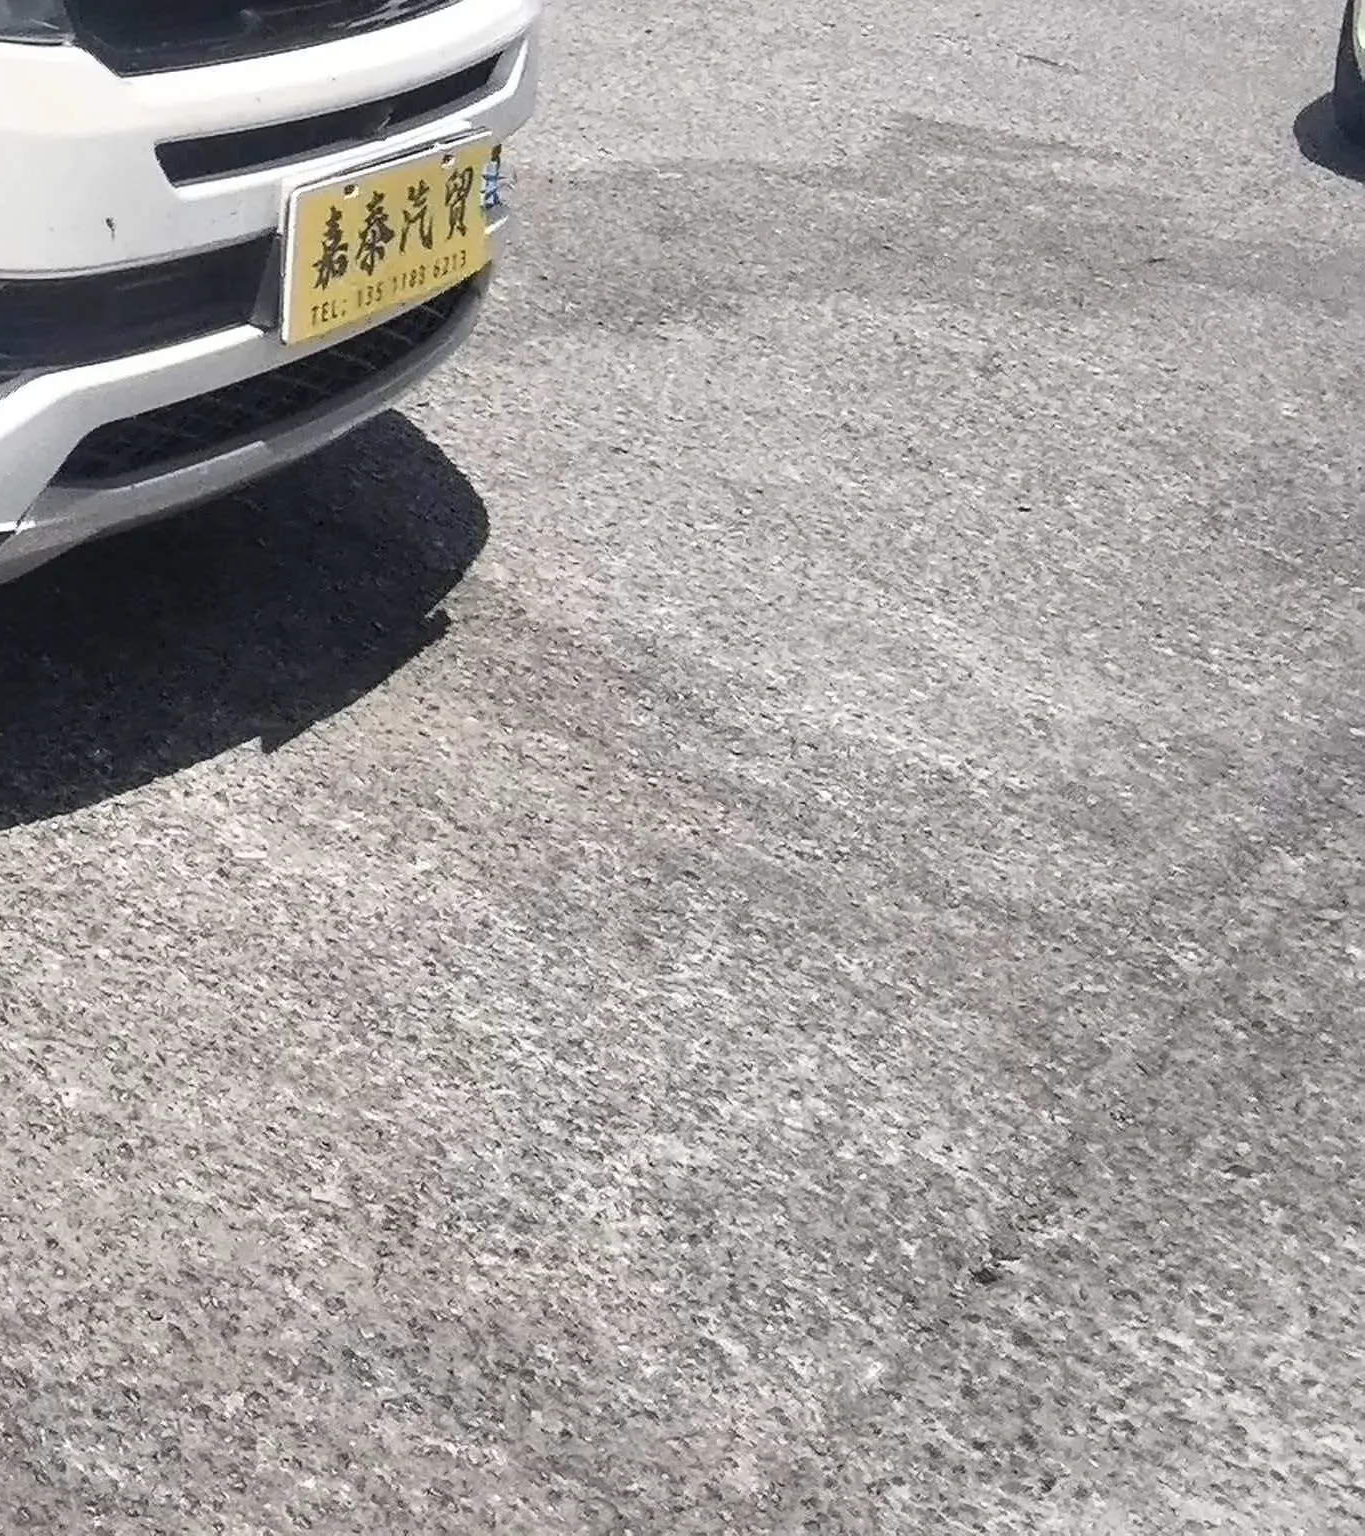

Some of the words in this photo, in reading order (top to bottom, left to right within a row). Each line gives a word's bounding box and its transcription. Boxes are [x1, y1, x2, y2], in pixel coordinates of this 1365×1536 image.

[311, 300, 348, 325] TEL:
[357, 282, 383, 307] 135
[392, 265, 426, 294] 1183
[432, 250, 467, 278] 6213
